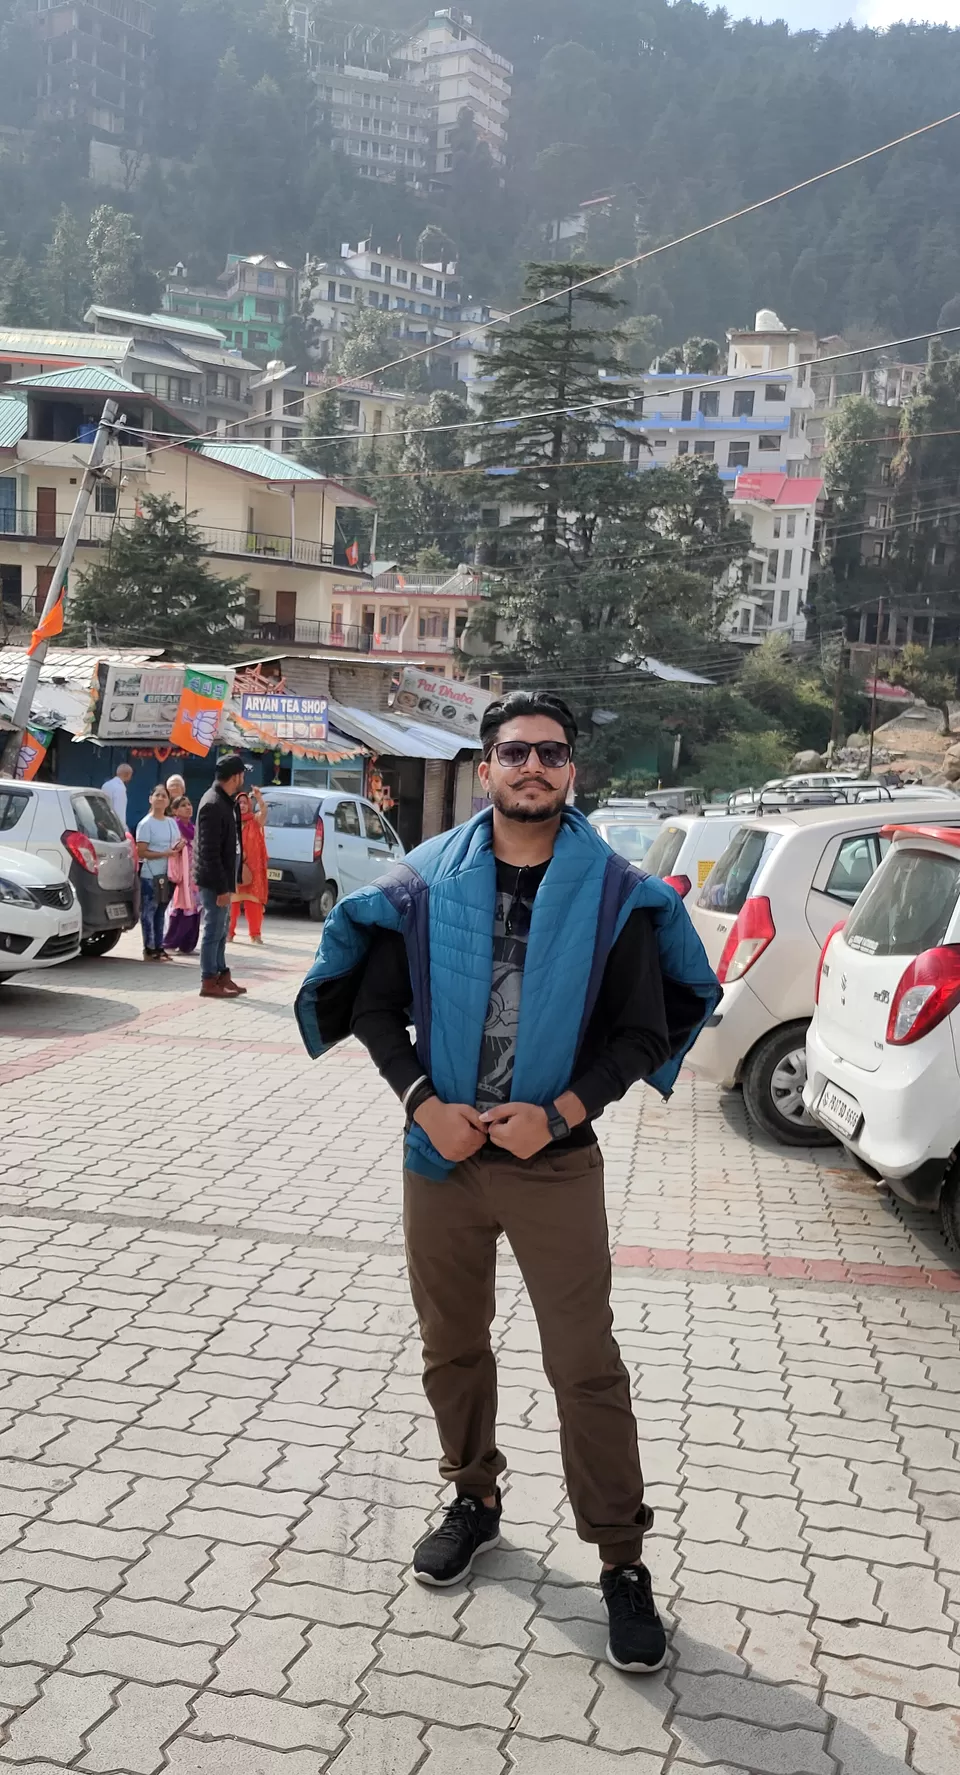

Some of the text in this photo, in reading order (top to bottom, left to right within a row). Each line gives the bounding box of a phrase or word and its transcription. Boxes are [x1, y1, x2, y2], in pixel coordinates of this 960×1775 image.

[417, 678, 436, 693] Pal
[439, 685, 474, 705] Dhaba
[245, 696, 327, 714] ARYAN TEA SHOP
